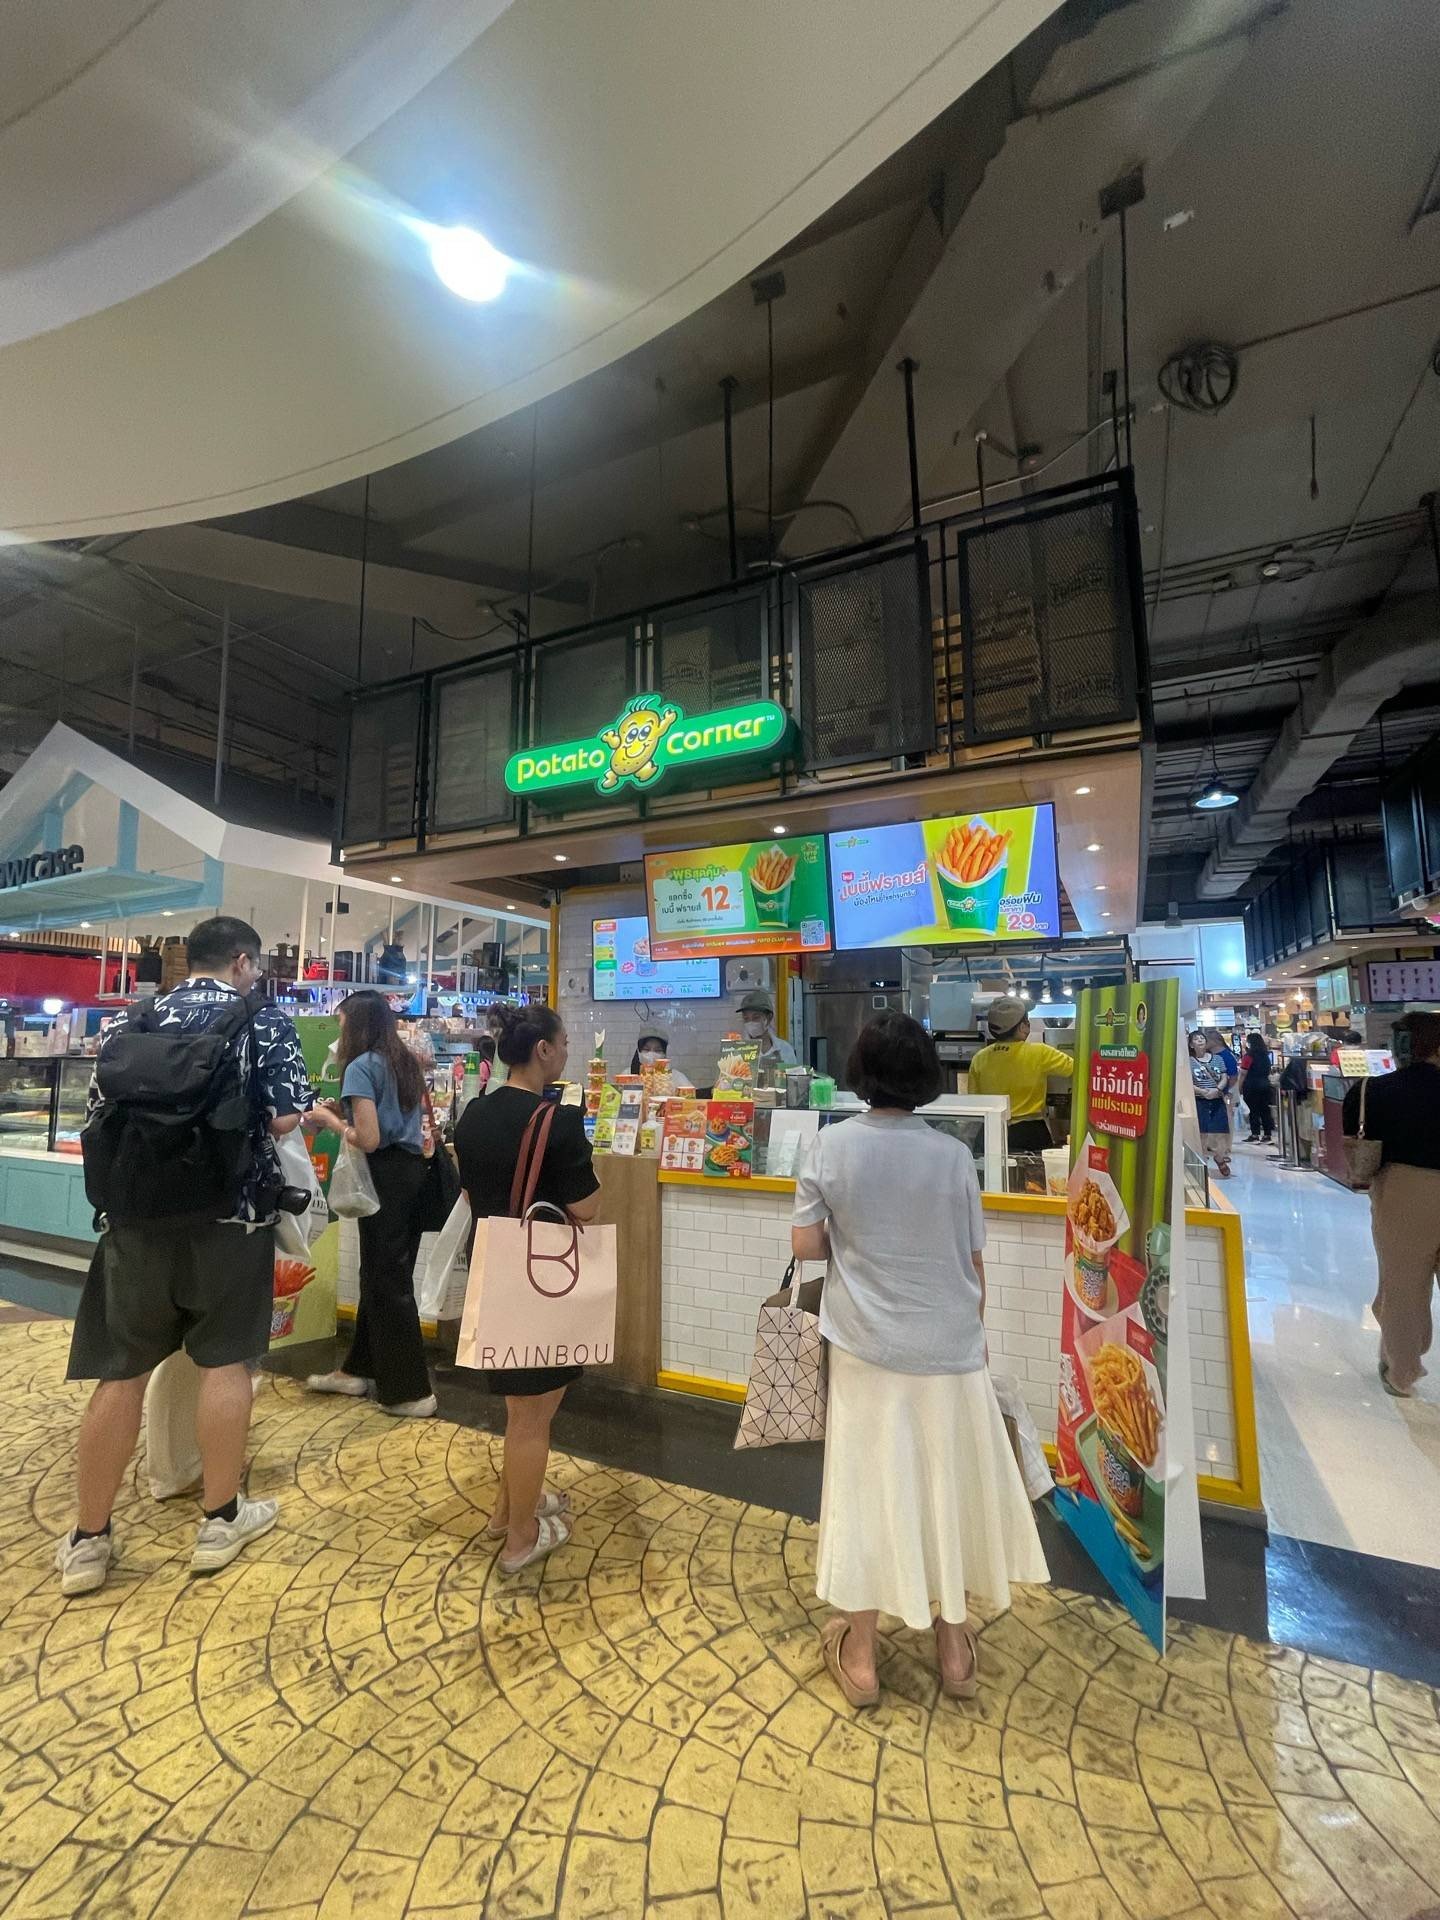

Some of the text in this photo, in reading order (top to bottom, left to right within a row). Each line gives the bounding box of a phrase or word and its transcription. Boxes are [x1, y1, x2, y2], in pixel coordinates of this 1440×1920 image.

[517, 748, 605, 784] Potato
[701, 885, 731, 912] 12
[1007, 913, 1035, 930] 29
[1092, 1065, 1144, 1098] น้ำจิ้มไก่
[1091, 1094, 1142, 1116] แม่ประนอม
[481, 1343, 609, 1369] RAINBOU
